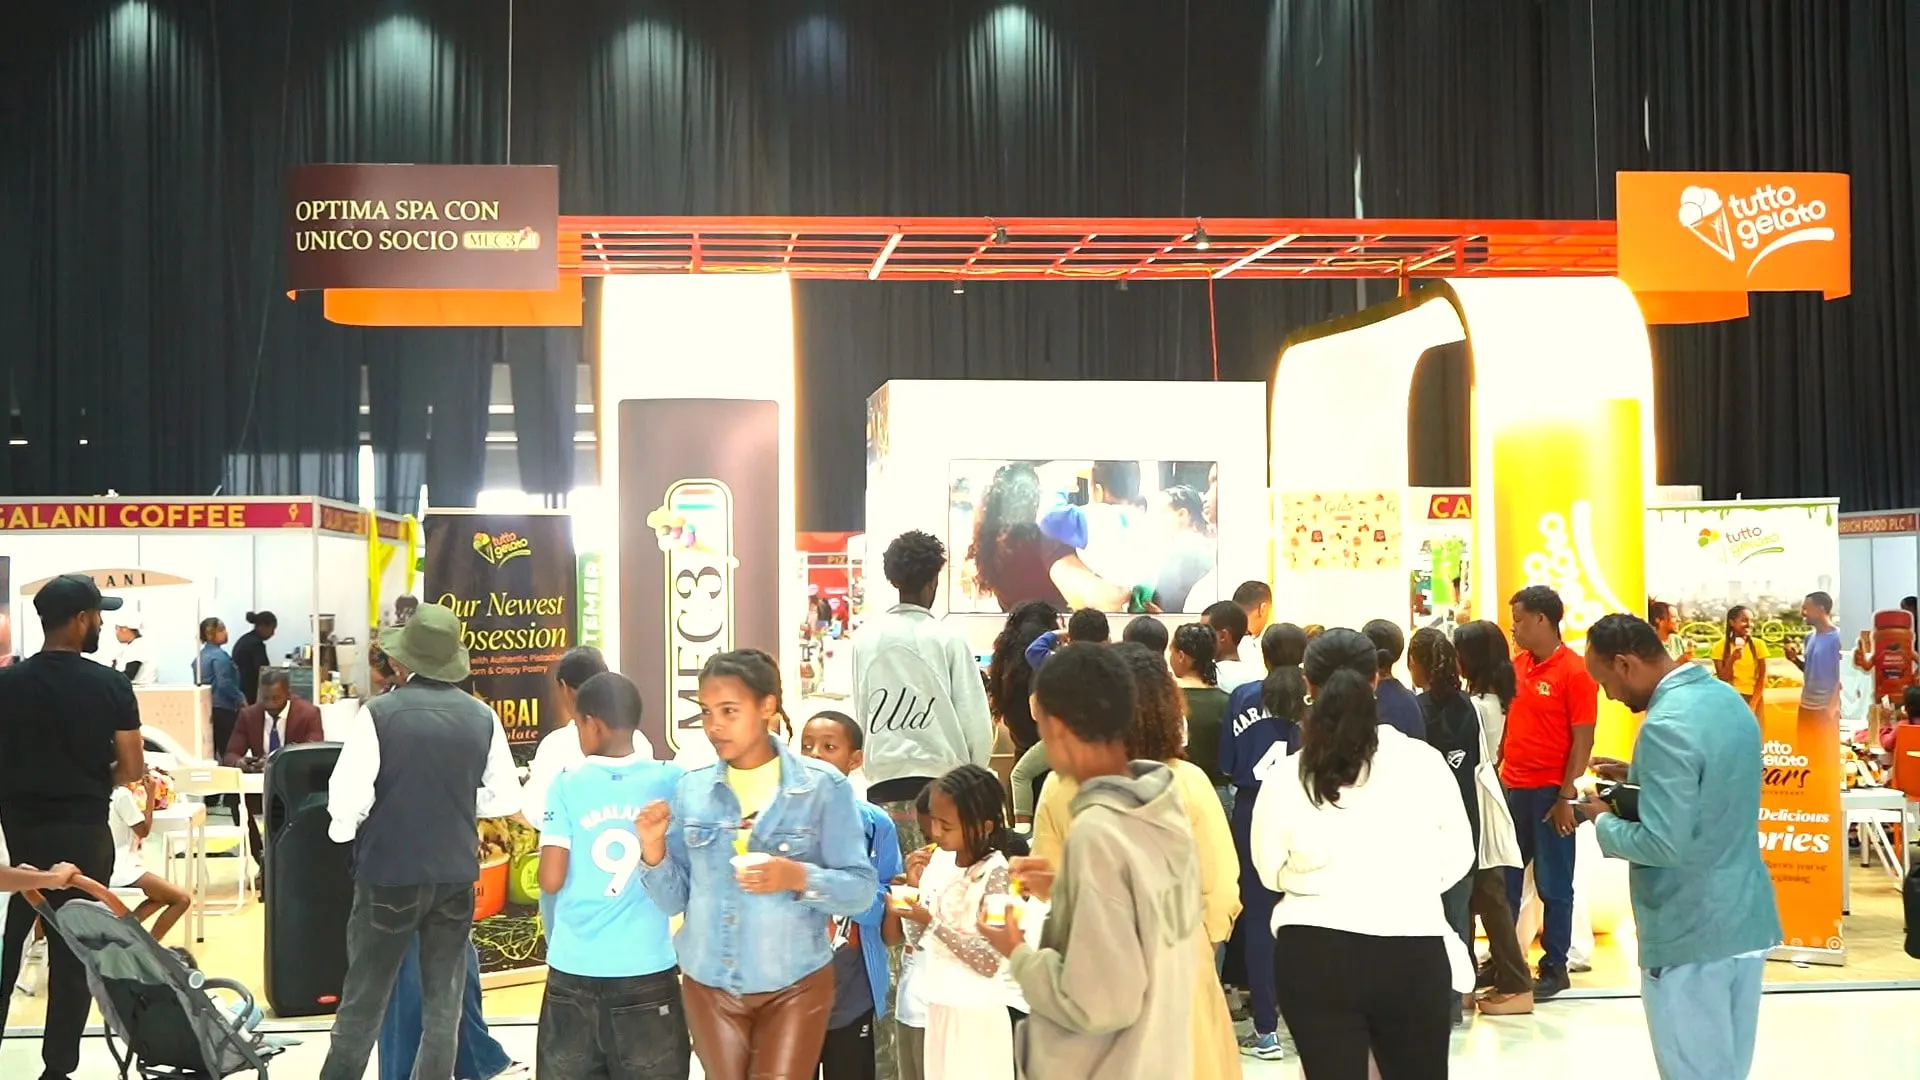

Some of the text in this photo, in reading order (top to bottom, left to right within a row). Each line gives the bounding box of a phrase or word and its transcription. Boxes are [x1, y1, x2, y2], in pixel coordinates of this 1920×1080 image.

[295, 199, 499, 221] OPTIMA SPA CON
[1727, 183, 1797, 220] tutto
[1736, 199, 1827, 250] gelato
[295, 229, 373, 251] UNICO
[378, 229, 458, 251] SOCIO
[0, 503, 246, 529] ALANI COFFEE
[1725, 526, 1762, 543] tutto
[437, 591, 566, 618] Our Newest
[459, 620, 567, 651] bsession
[1763, 754, 1809, 768] elato
[1758, 807, 1831, 824] Delicious
[590, 827, 642, 897] 9
